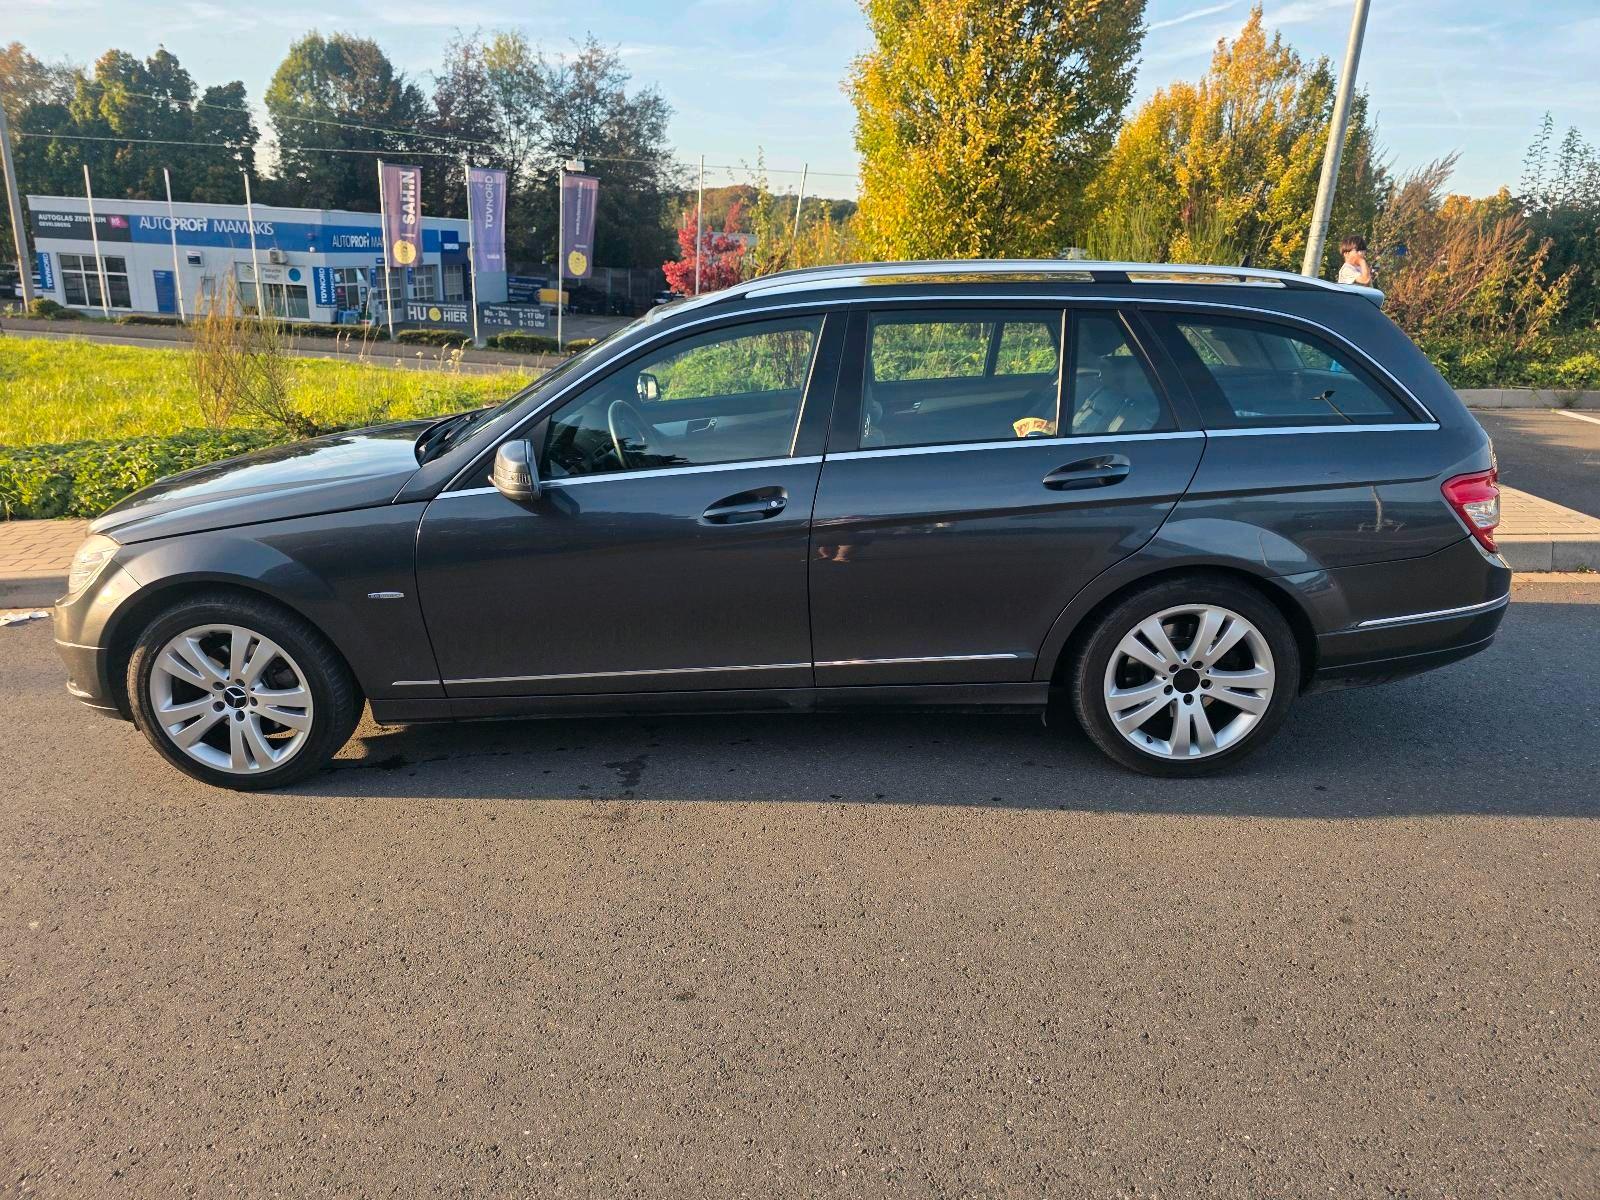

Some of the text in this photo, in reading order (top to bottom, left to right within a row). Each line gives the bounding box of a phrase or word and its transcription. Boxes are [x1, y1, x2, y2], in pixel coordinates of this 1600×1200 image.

[38, 213, 74, 222] AUTOGLAS
[74, 215, 107, 224] ZENTUM
[407, 306, 468, 323] HU HIER
